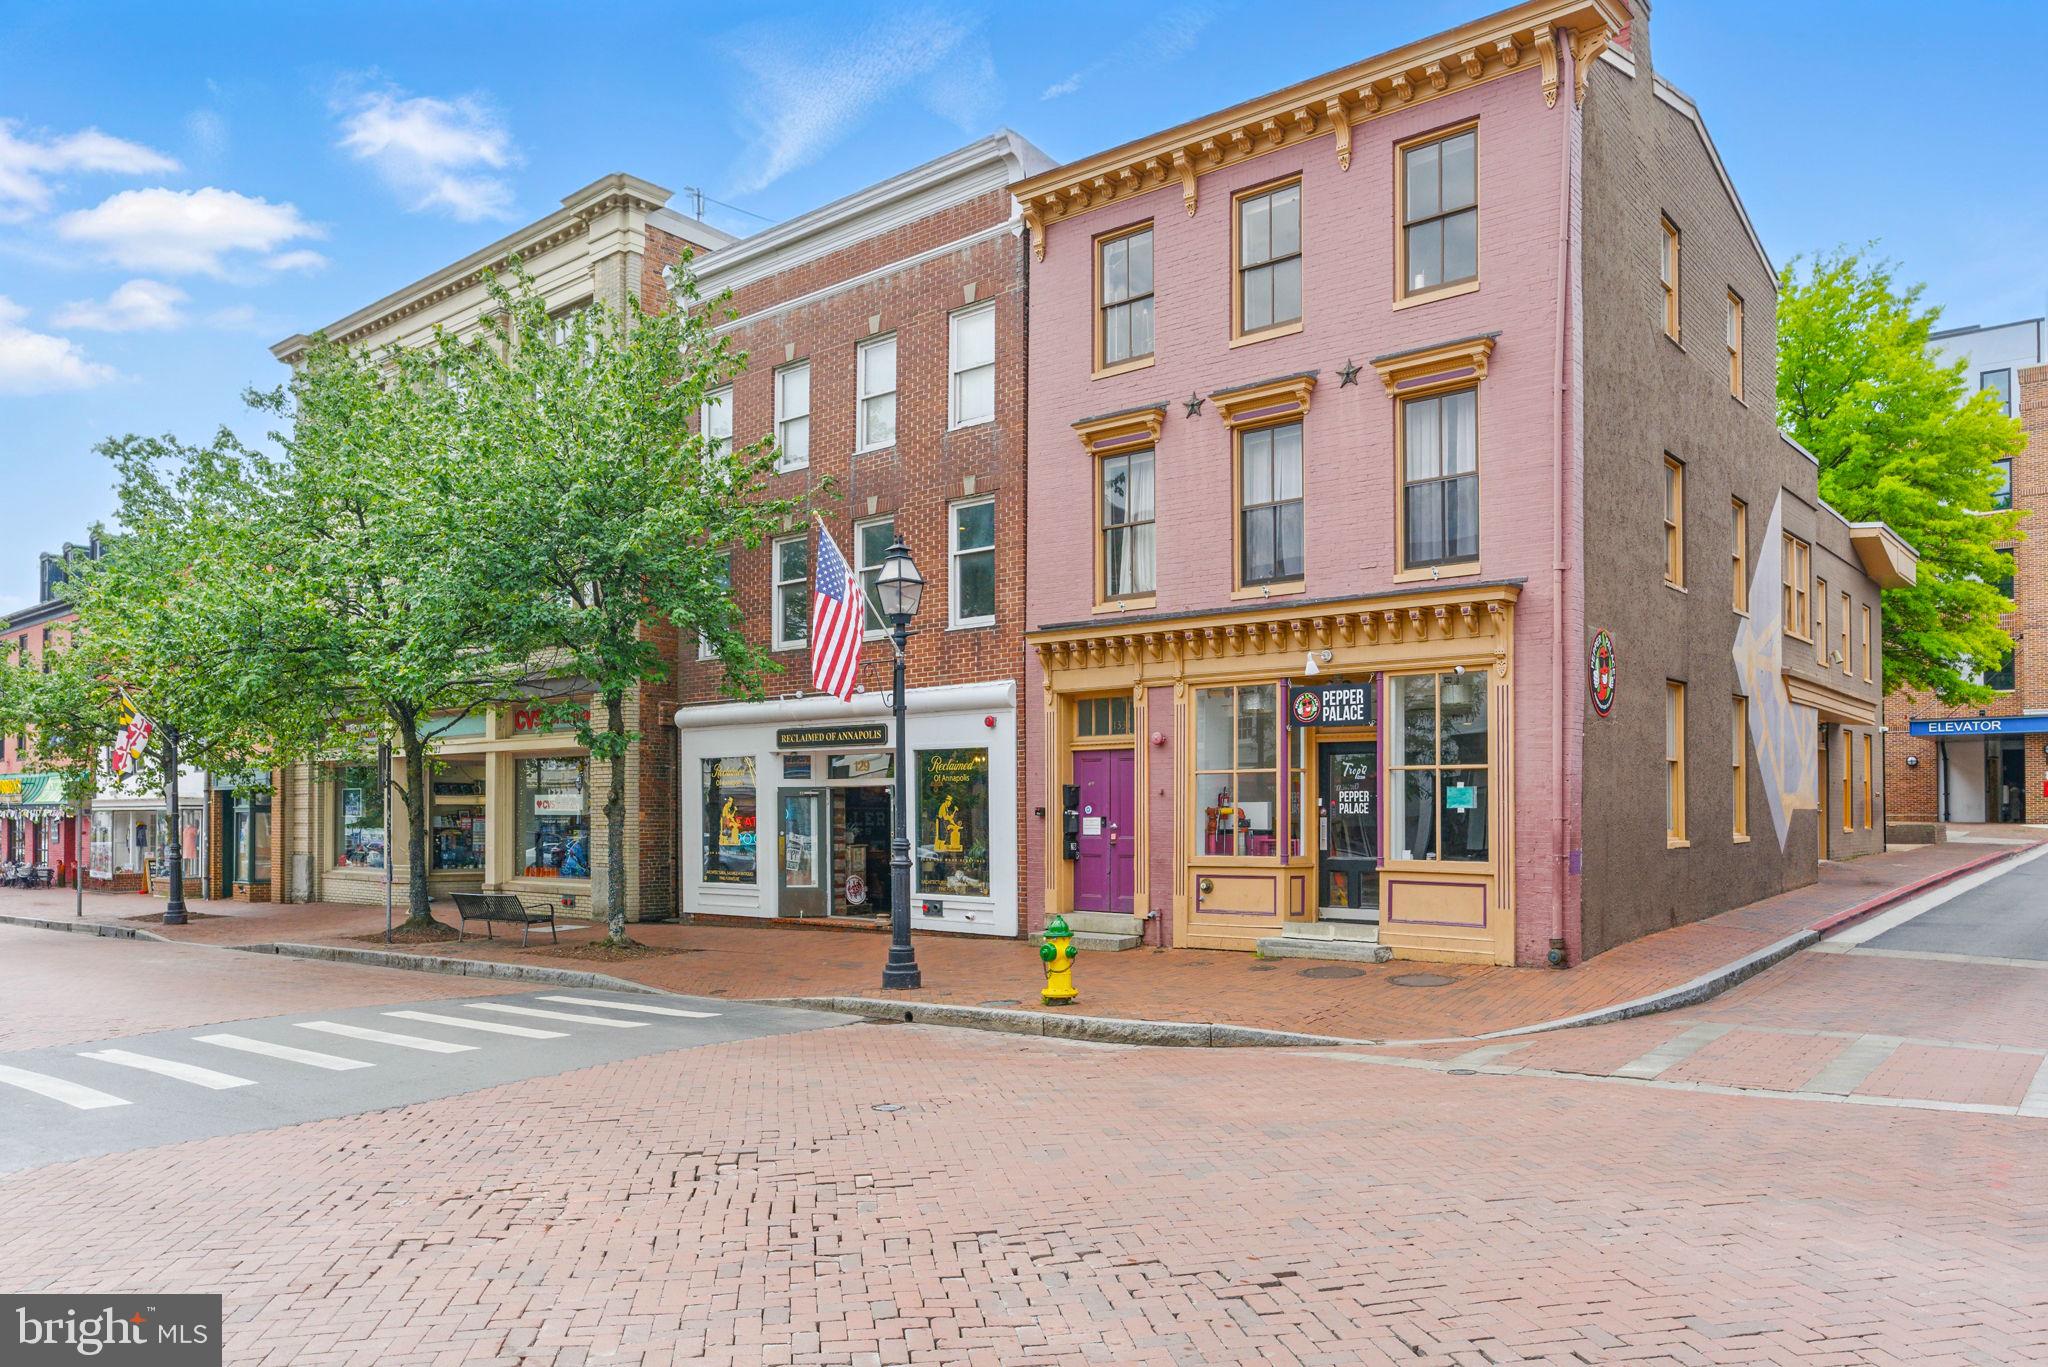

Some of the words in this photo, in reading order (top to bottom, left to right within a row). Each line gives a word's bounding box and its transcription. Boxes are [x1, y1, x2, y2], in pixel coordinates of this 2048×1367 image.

[1322, 689, 1364, 706] PEPPER
[1322, 705, 1364, 722] PALACE
[1928, 720, 2002, 733] ELEVATOR
[781, 733, 825, 743] RECLAIMED
[825, 732, 836, 741] OF
[836, 730, 882, 740] ANNAPOLIS
[853, 760, 870, 772] 129
[927, 755, 975, 773] Reclaimed
[942, 773, 970, 784] Annapolis
[1339, 790, 1370, 802] PEPPER
[1339, 802, 1369, 814] PALACE
